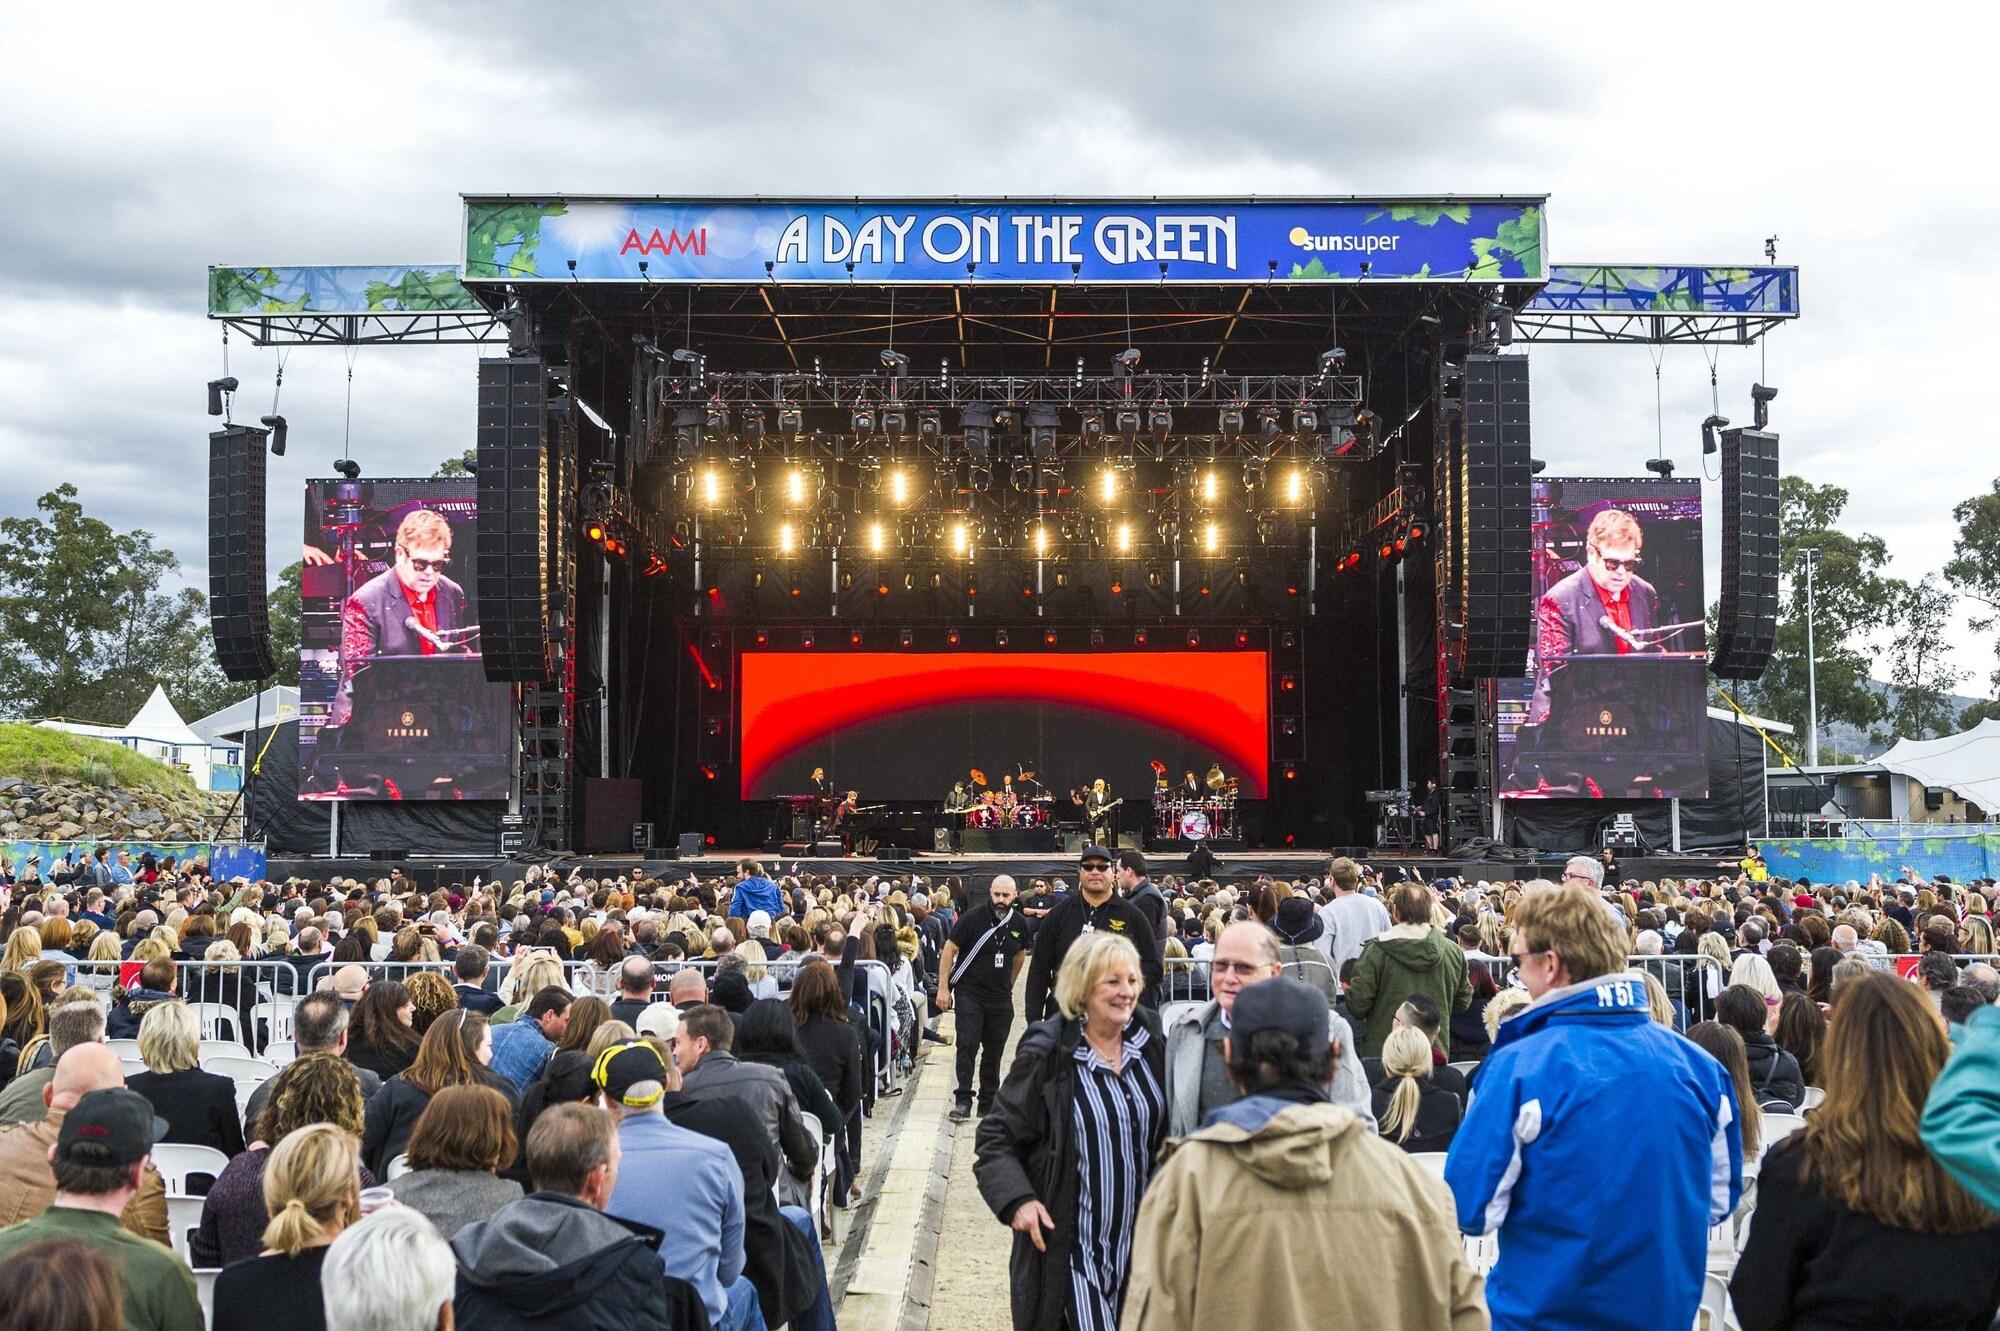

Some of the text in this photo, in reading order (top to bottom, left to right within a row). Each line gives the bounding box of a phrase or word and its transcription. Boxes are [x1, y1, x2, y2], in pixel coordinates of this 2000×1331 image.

[620, 227, 706, 256] AAMI
[776, 214, 1237, 271] A DAY ON THE GREEN
[1303, 235, 1400, 255] sunsuper
